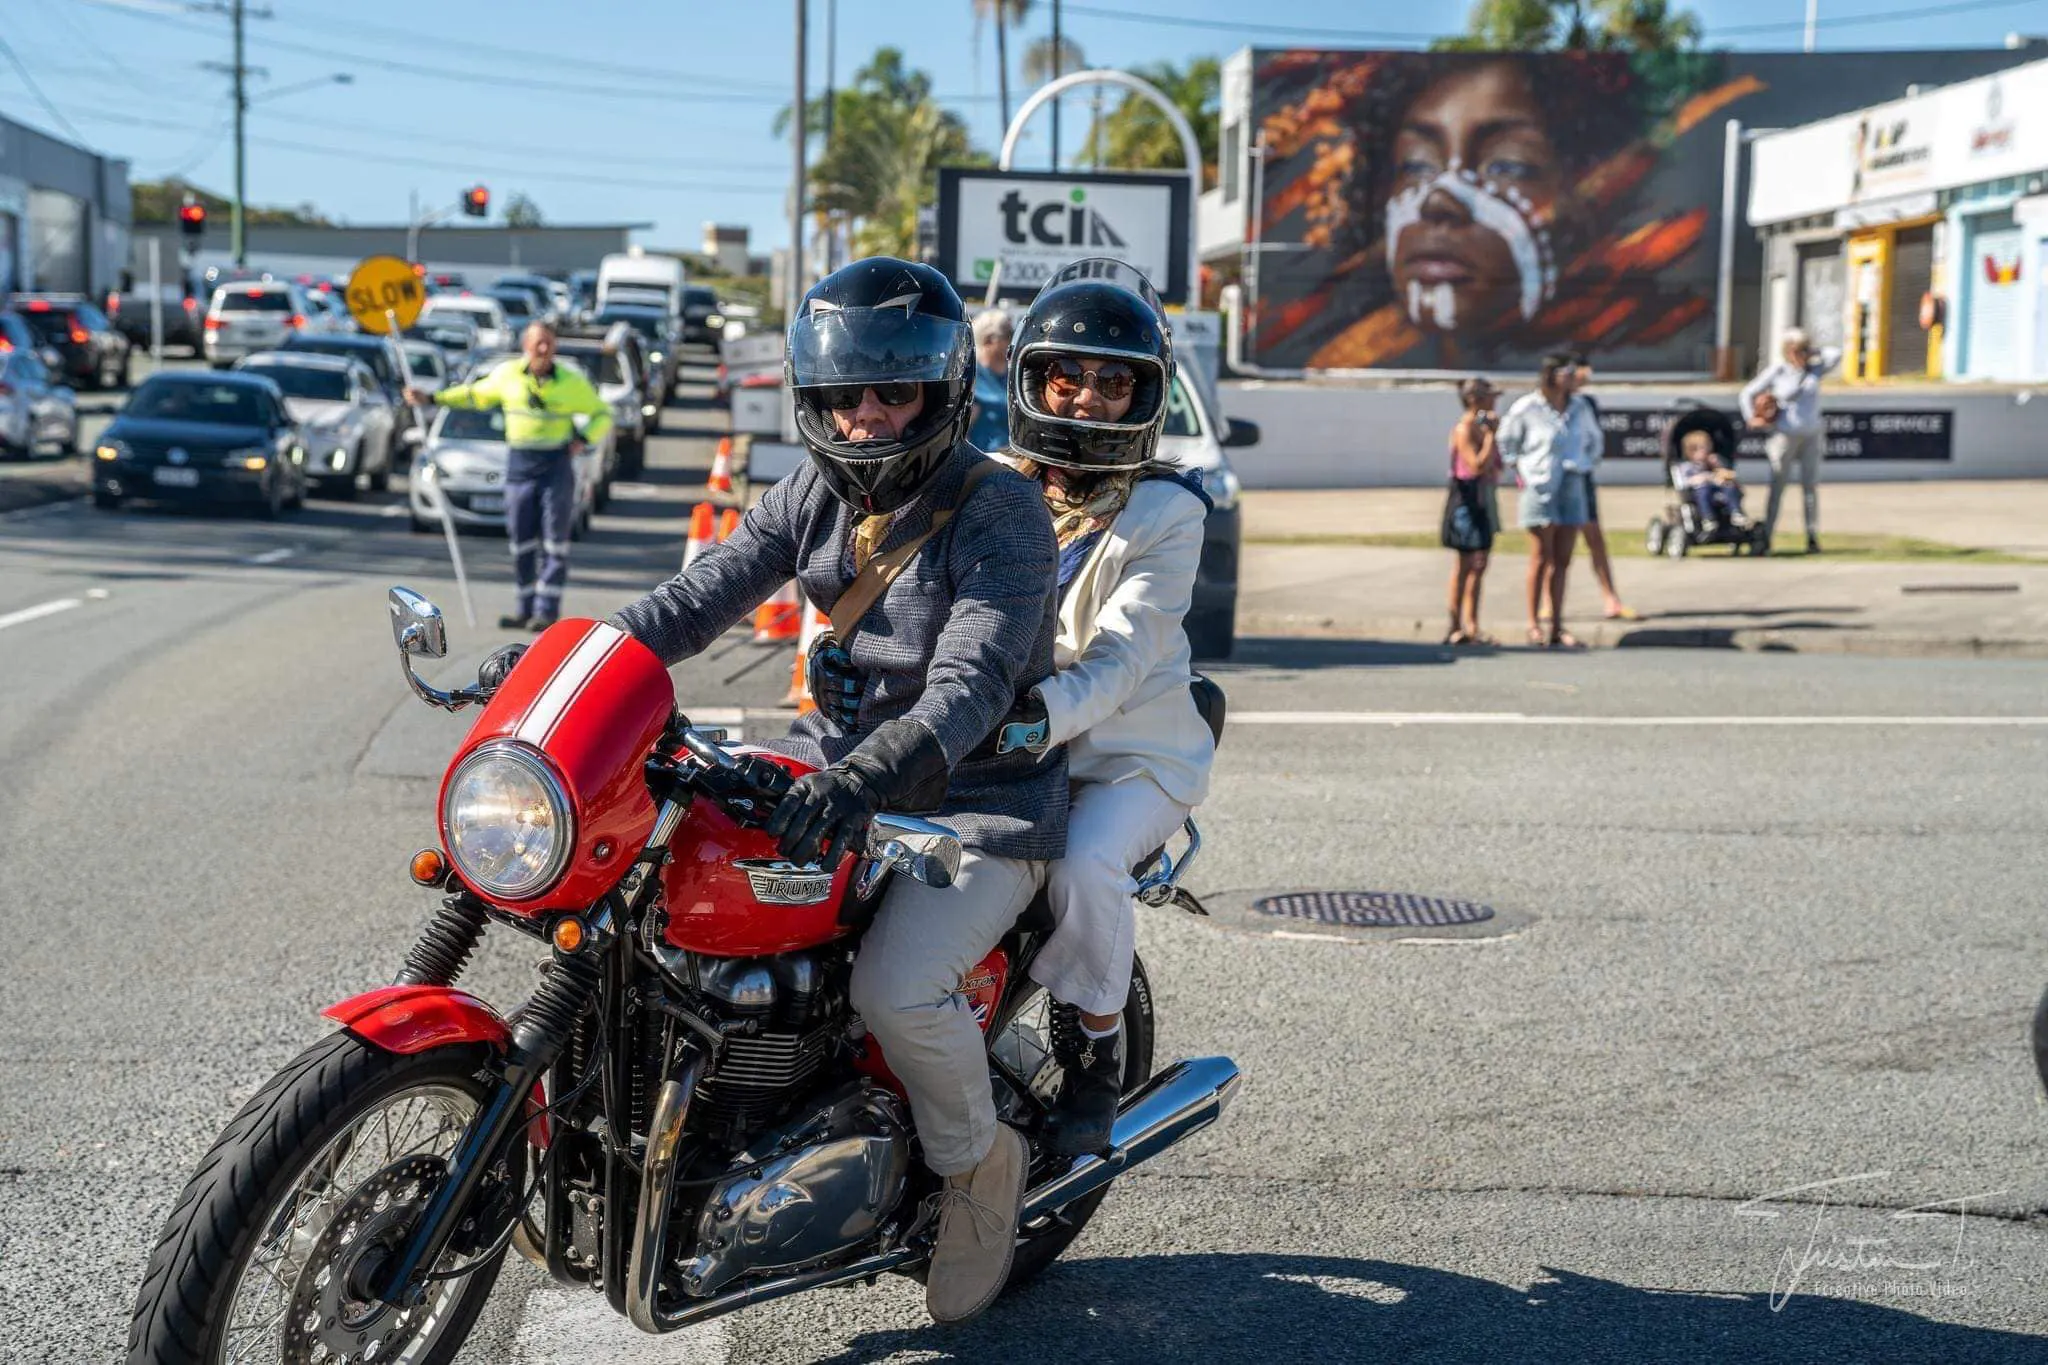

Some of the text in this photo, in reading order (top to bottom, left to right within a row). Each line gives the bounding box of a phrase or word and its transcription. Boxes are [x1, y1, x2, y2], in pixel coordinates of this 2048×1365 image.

[351, 278, 418, 315] SLOW
[764, 878, 829, 897] TRIUMPH
[1132, 976, 1151, 1016] AVON
